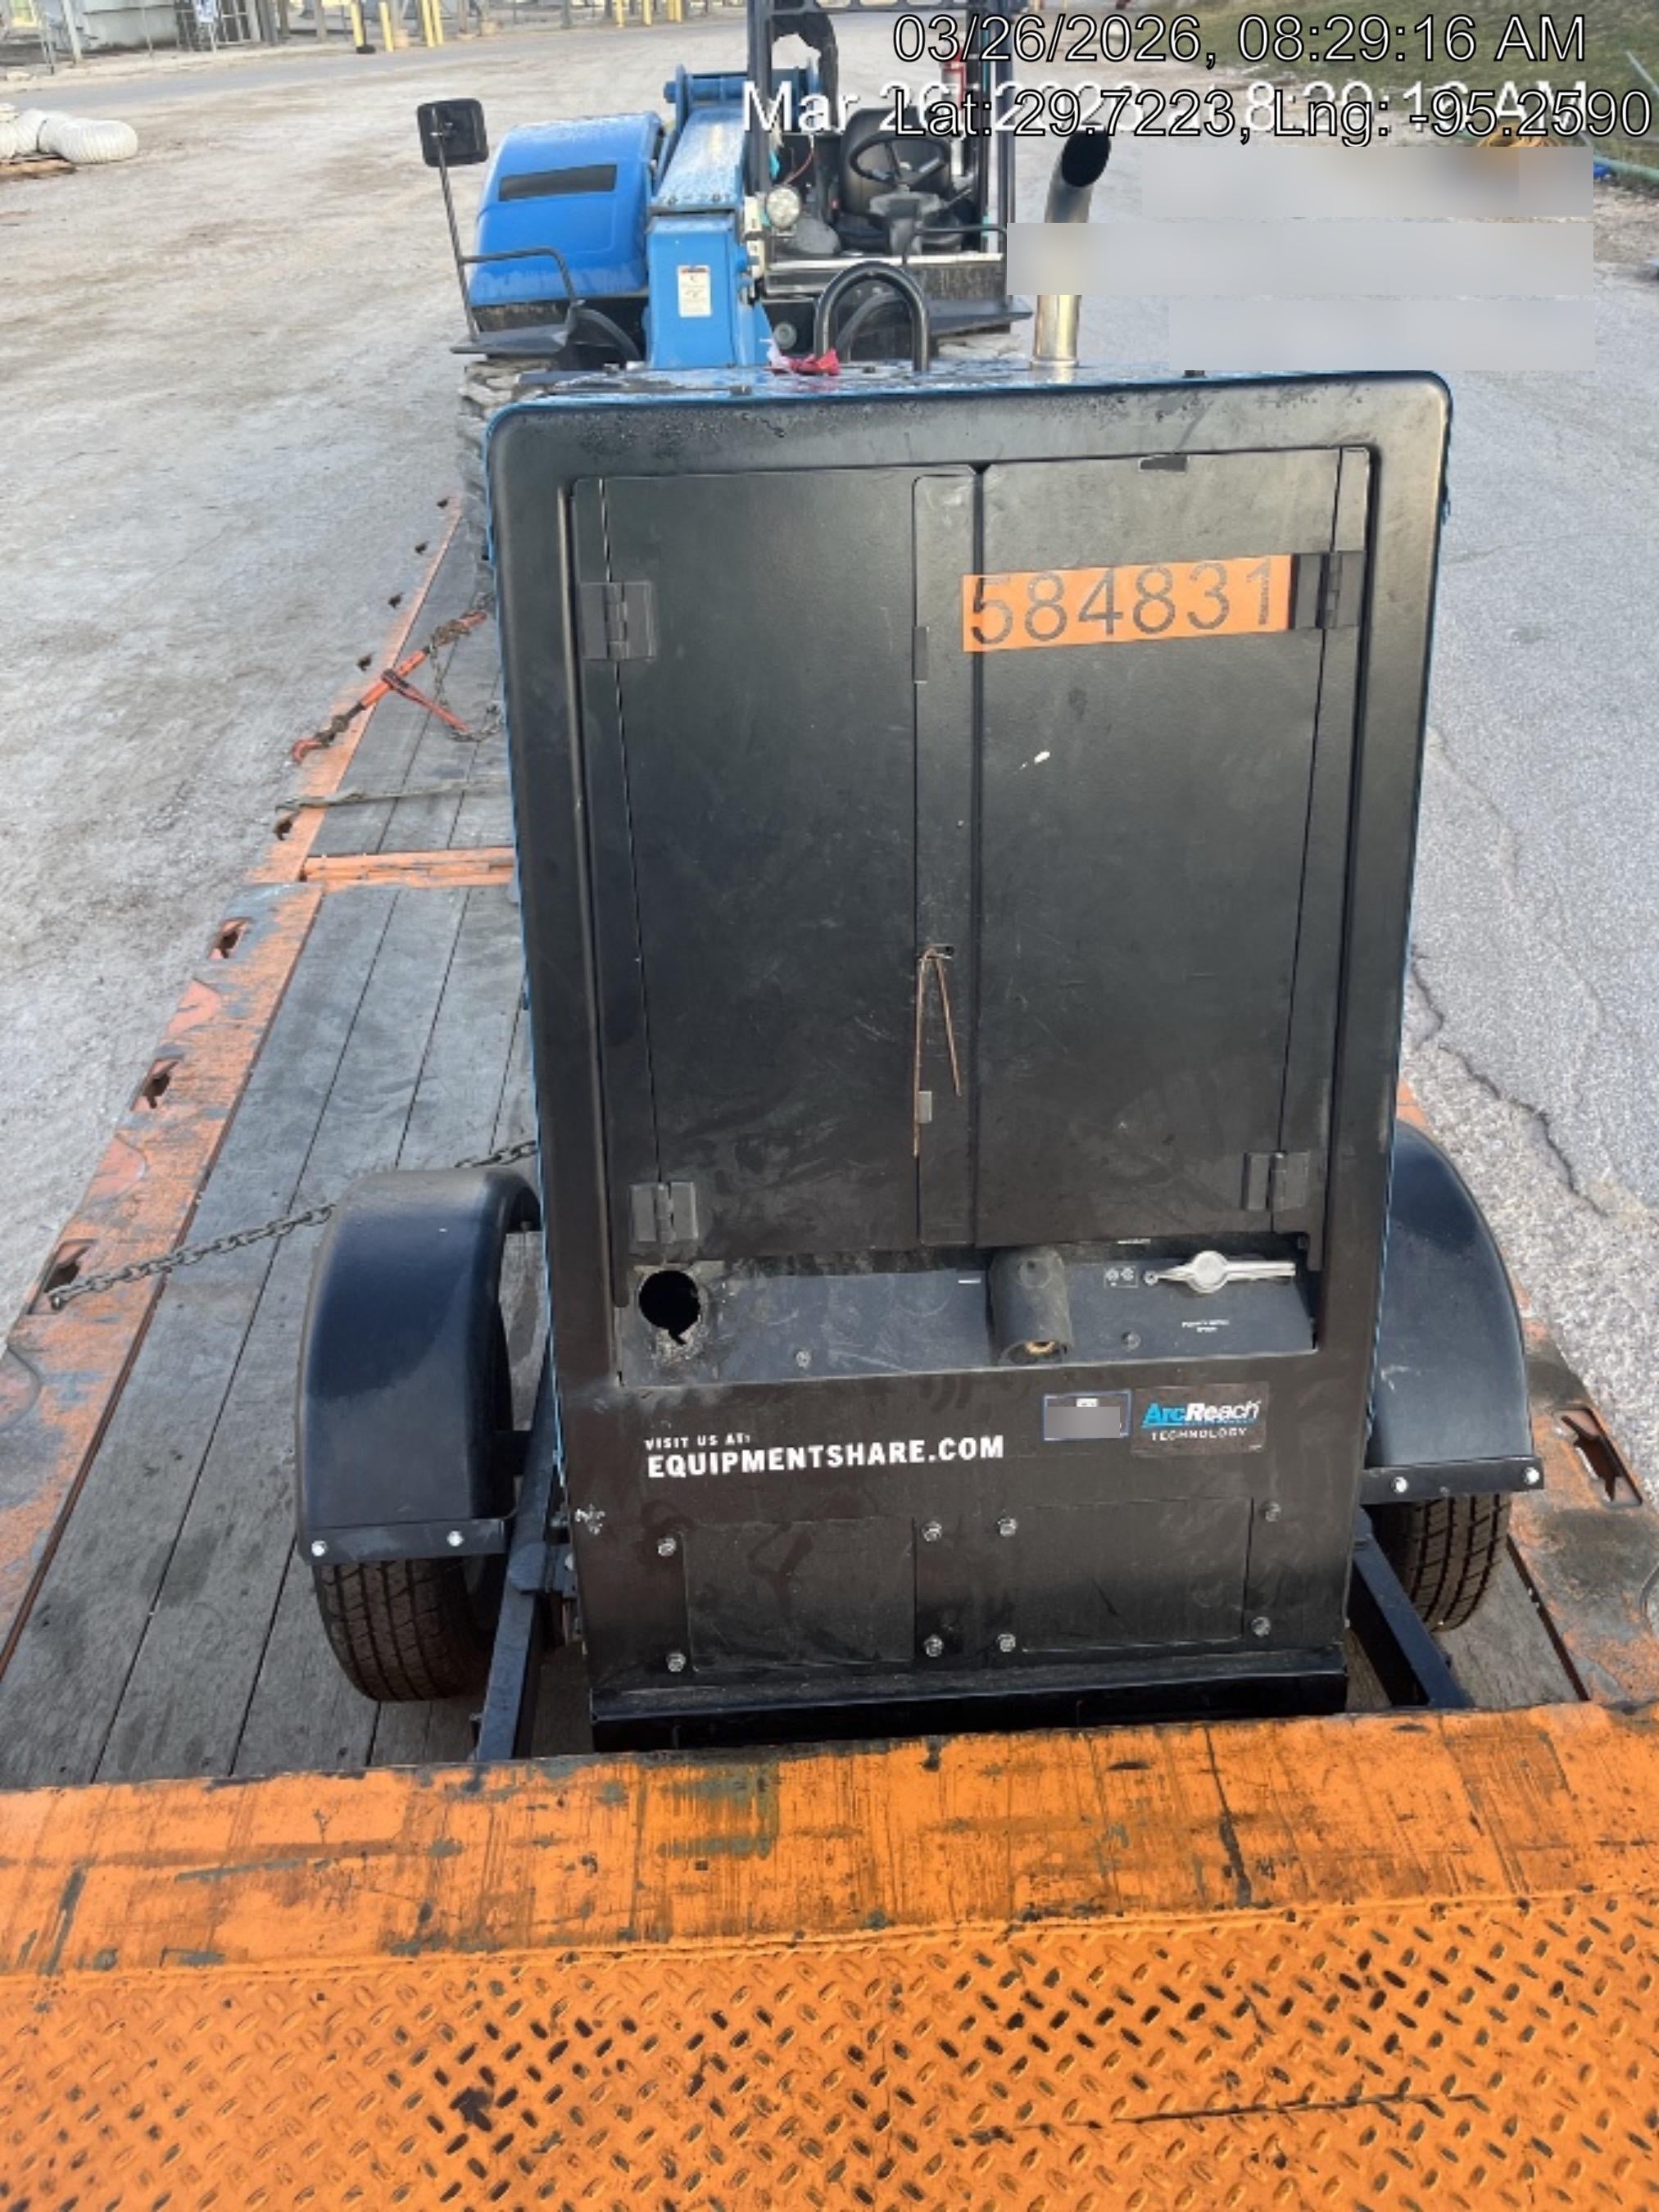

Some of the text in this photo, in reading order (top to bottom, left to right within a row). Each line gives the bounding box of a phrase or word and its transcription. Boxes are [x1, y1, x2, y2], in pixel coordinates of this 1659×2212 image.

[970, 556, 1271, 646] 584831
[1145, 1400, 1260, 1423] ArcReach
[644, 1436, 689, 1451] VISIT
[696, 1435, 719, 1447] US
[1152, 1427, 1248, 1442] TECHNOLOGY
[647, 1435, 1004, 1479] EQUIPMENTSHARE.COM
